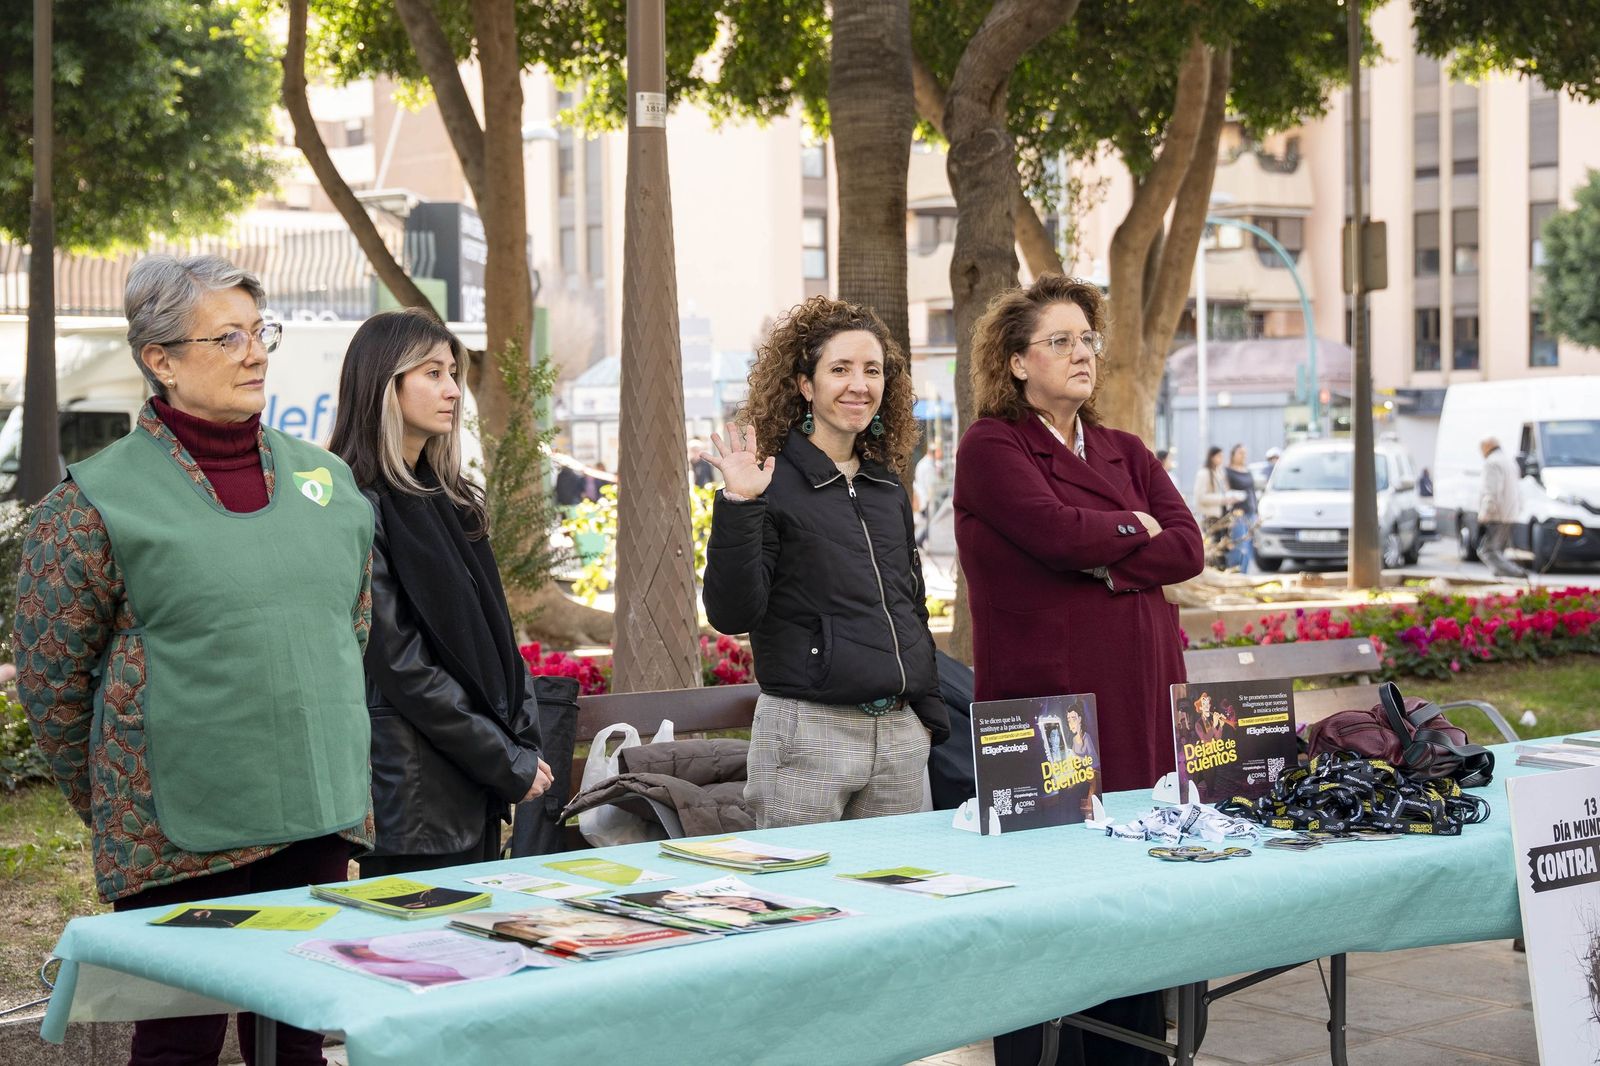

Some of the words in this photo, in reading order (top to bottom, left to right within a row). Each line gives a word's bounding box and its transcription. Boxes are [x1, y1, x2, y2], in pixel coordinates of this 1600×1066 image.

[1082, 755, 1093, 767] de
[1184, 738, 1225, 761] Déjate
[1225, 739, 1236, 749] de
[1186, 749, 1238, 774] cuentos
[1043, 766, 1095, 794] cuentos
[1584, 797, 1598, 816] 13
[1553, 819, 1572, 842] DÍA
[1536, 846, 1598, 883] CONTRA
